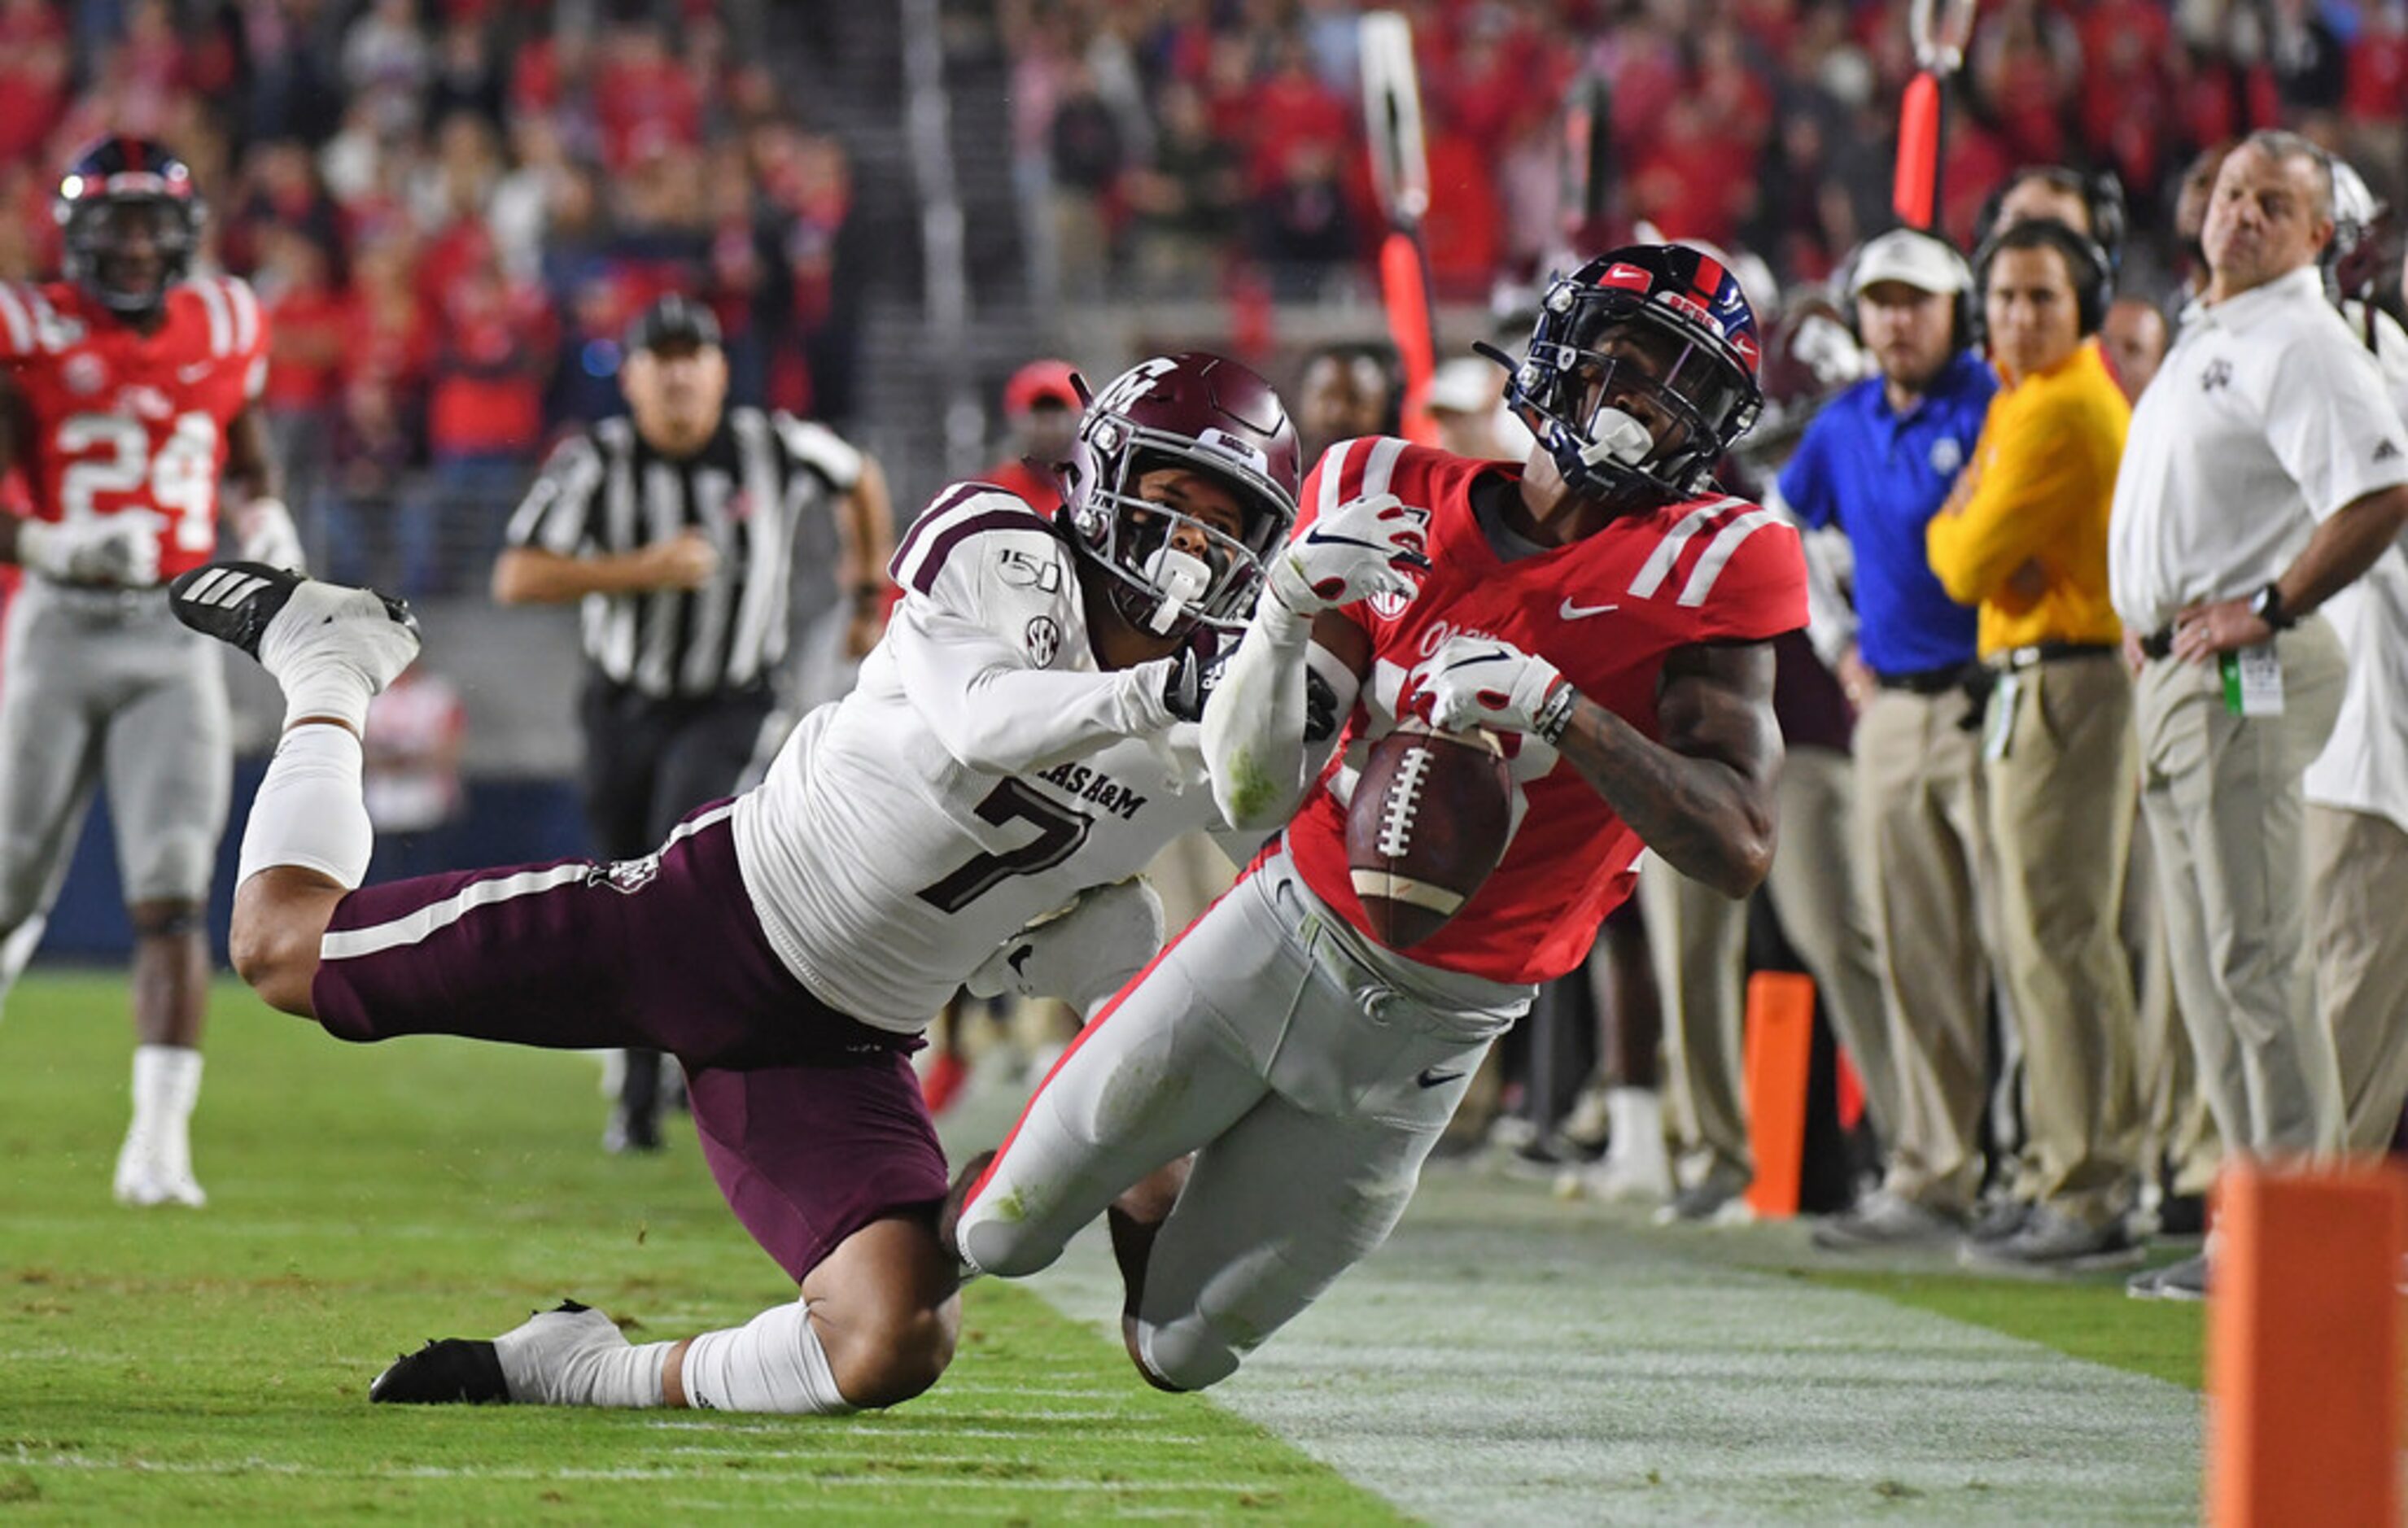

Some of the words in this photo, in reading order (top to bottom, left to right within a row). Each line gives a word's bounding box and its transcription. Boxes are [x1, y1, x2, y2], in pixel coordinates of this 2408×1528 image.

[55, 411, 218, 552] 24
[914, 775, 1095, 915] 7
[1082, 774, 1148, 821] A&M
